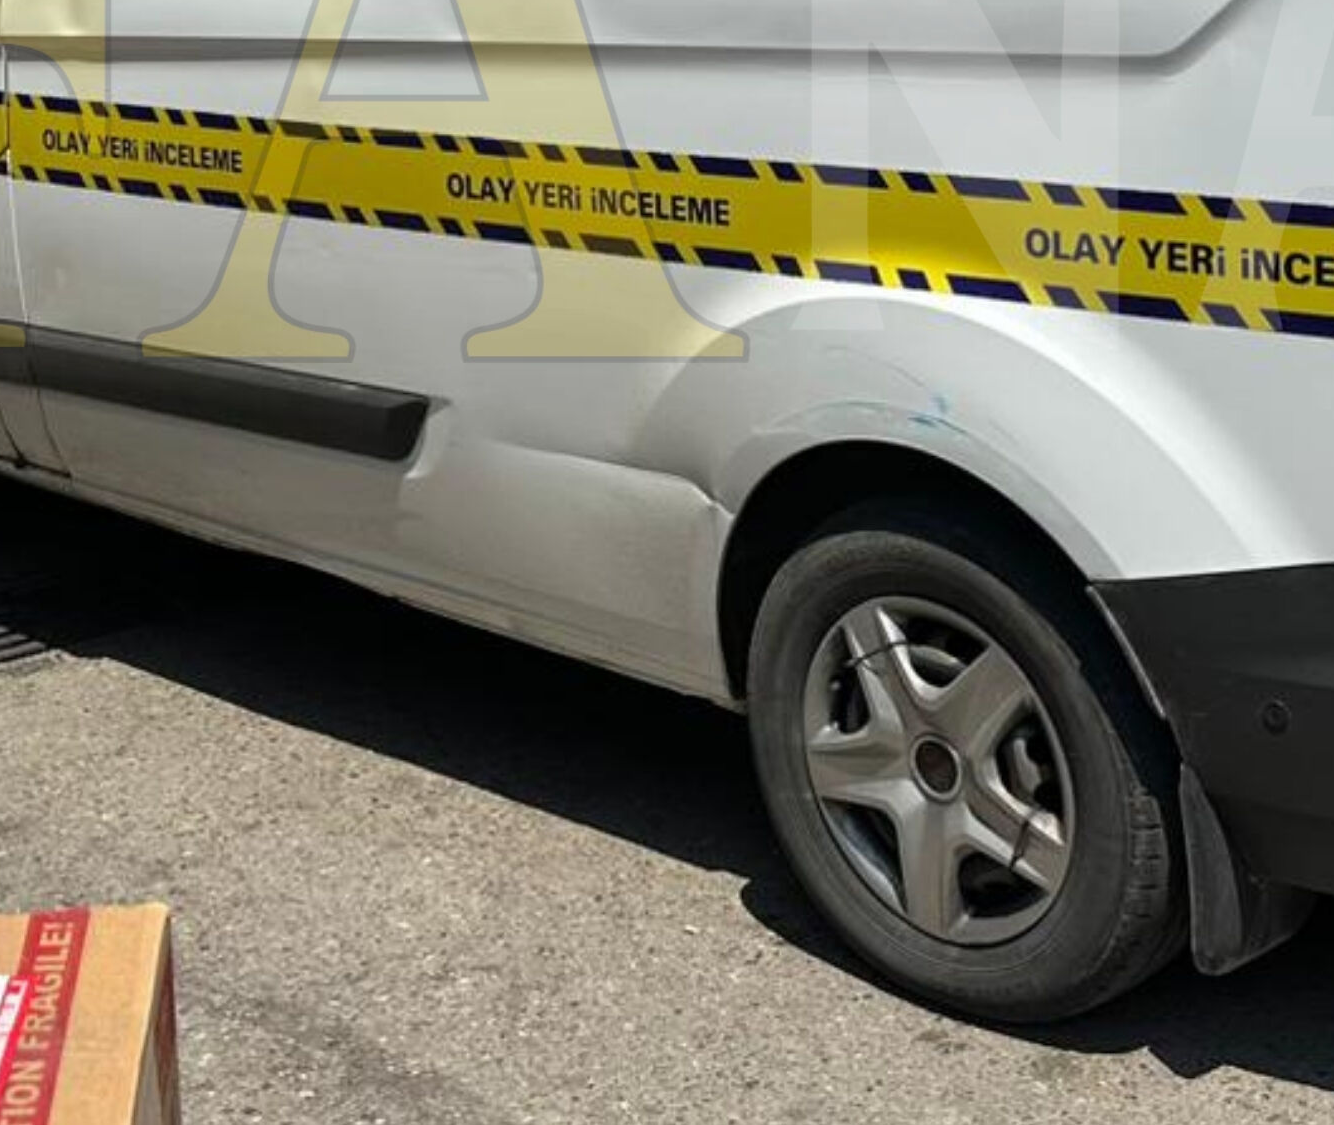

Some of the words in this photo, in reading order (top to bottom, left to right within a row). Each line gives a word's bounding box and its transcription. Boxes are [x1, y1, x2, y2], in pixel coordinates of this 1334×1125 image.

[43, 128, 91, 155] OLAY
[447, 172, 514, 203] OLAY
[1026, 227, 1125, 265] OLAY
